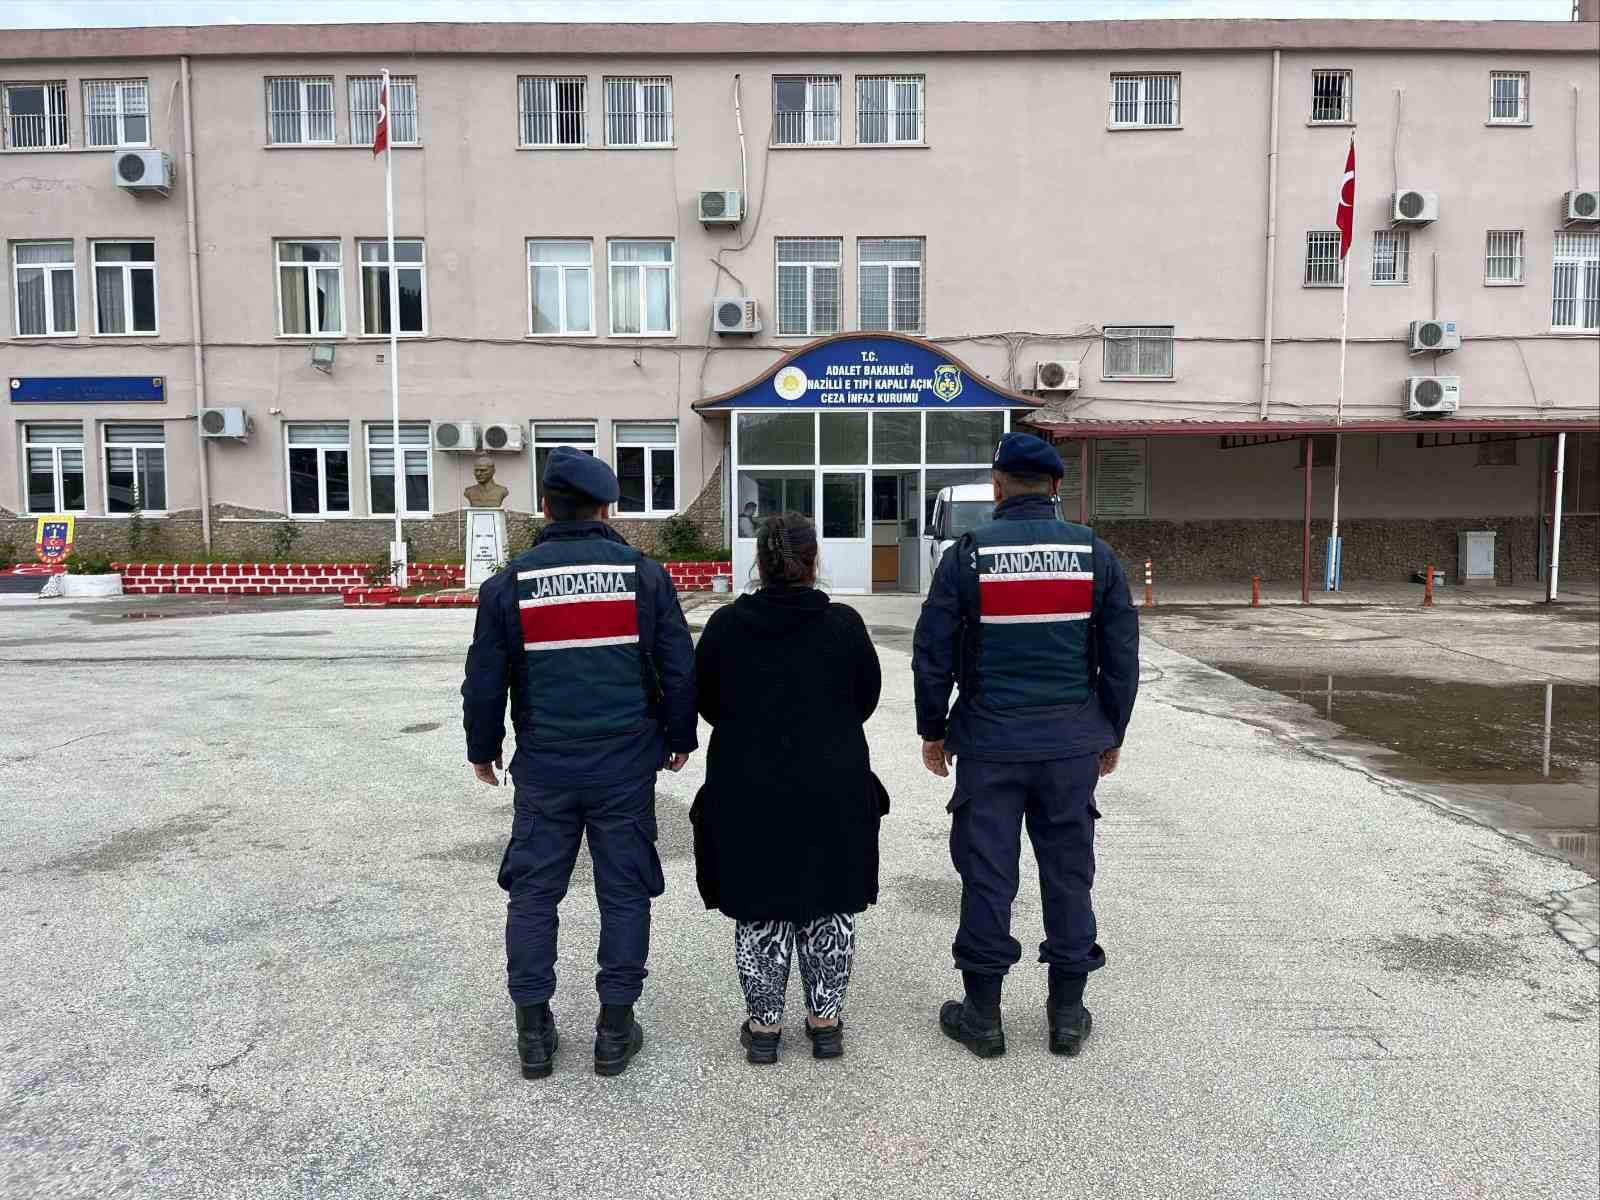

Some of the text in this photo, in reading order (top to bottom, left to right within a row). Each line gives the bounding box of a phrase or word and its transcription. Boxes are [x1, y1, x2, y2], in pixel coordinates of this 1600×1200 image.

[861, 351, 879, 362] T.C.
[825, 362, 914, 376] ADALET BAKANLIĞI
[807, 377, 842, 390] NAZİLLİ
[844, 379, 851, 390] E
[874, 379, 907, 390] KAPALI
[909, 378, 932, 392] AÇIK
[820, 391, 919, 404] CEZA İNFAZ KURUMU
[990, 551, 1081, 574] JANDARMA
[531, 572, 628, 599] JANDARMA
